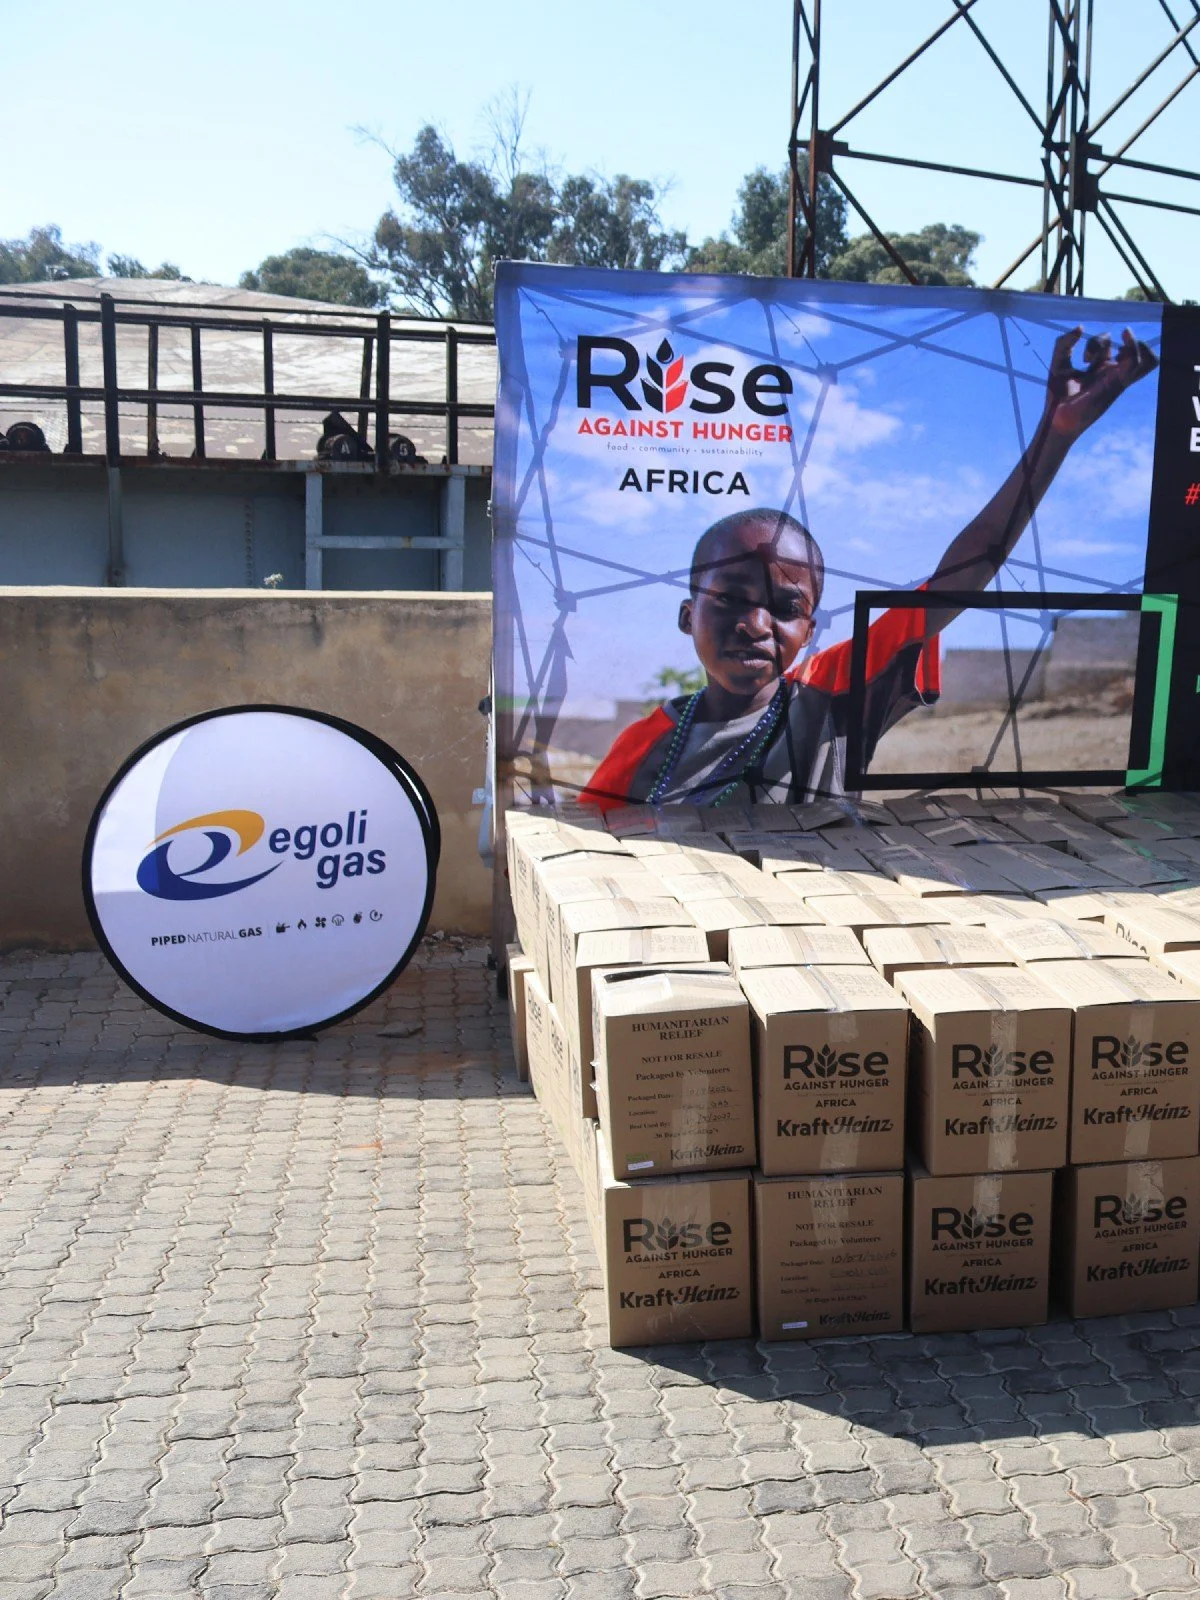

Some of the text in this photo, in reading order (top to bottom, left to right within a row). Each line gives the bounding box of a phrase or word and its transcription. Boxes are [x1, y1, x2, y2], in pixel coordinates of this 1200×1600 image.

[578, 416, 793, 443] AGAINST HUNGER
[607, 442, 764, 457] food community sustainability
[619, 467, 750, 496] AFRICA
[268, 809, 368, 860] egoli
[315, 849, 386, 889] gas
[632, 1016, 729, 1032] HUMANITARIAN
[660, 1029, 704, 1041] RELIEF
[641, 1051, 722, 1064] NOT FOR RESALE
[636, 1072, 674, 1081] Packaged
[1092, 1067, 1189, 1080] AGAINST HUNGER
[784, 1078, 889, 1091] AGAINST HUNGER
[953, 1077, 1055, 1090] AGAINST HUNGER
[1120, 1087, 1158, 1096] AFRICA
[815, 1099, 856, 1108] AFRICA
[982, 1097, 1022, 1106] AFRICA
[787, 1186, 883, 1200] HUMANITARIAN
[814, 1198, 857, 1209] RELIEF
[796, 1223, 814, 1231] NOT
[838, 1219, 875, 1229] RESALE
[1094, 1220, 1187, 1238] AGAINST HUNGER
[789, 1239, 826, 1248] Packaged
[840, 1235, 881, 1244] Volunteers
[932, 1238, 1034, 1251] AGAINST HUNGER
[1121, 1242, 1158, 1252] AFRICA
[626, 1247, 733, 1263] AGAINST HUNGER
[962, 1258, 1003, 1268] AFRICA
[658, 1269, 700, 1279] AFRICA
